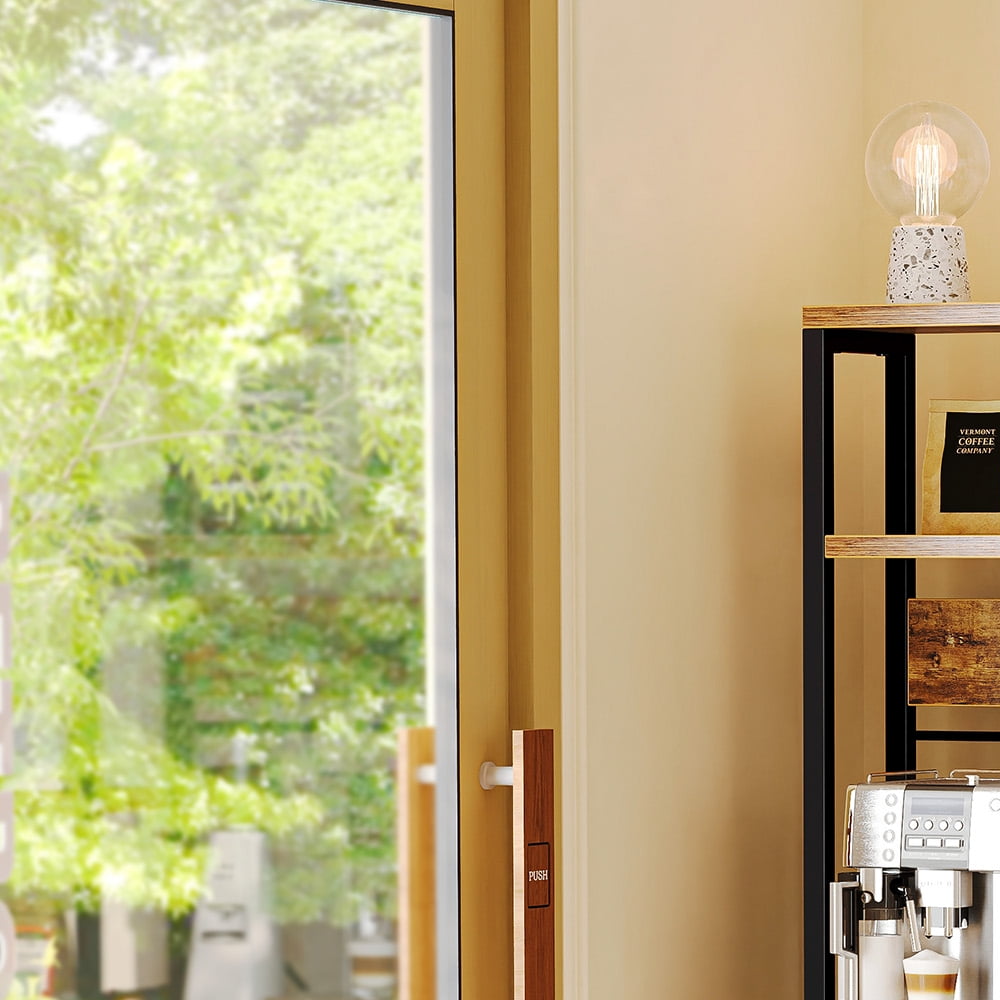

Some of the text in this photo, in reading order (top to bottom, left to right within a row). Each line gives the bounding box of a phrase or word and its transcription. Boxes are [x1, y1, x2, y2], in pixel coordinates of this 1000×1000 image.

[960, 428, 996, 436] VERMONT
[958, 437, 995, 446] COFFEE
[956, 446, 995, 455] COMPANY
[528, 870, 549, 882] PUSH
